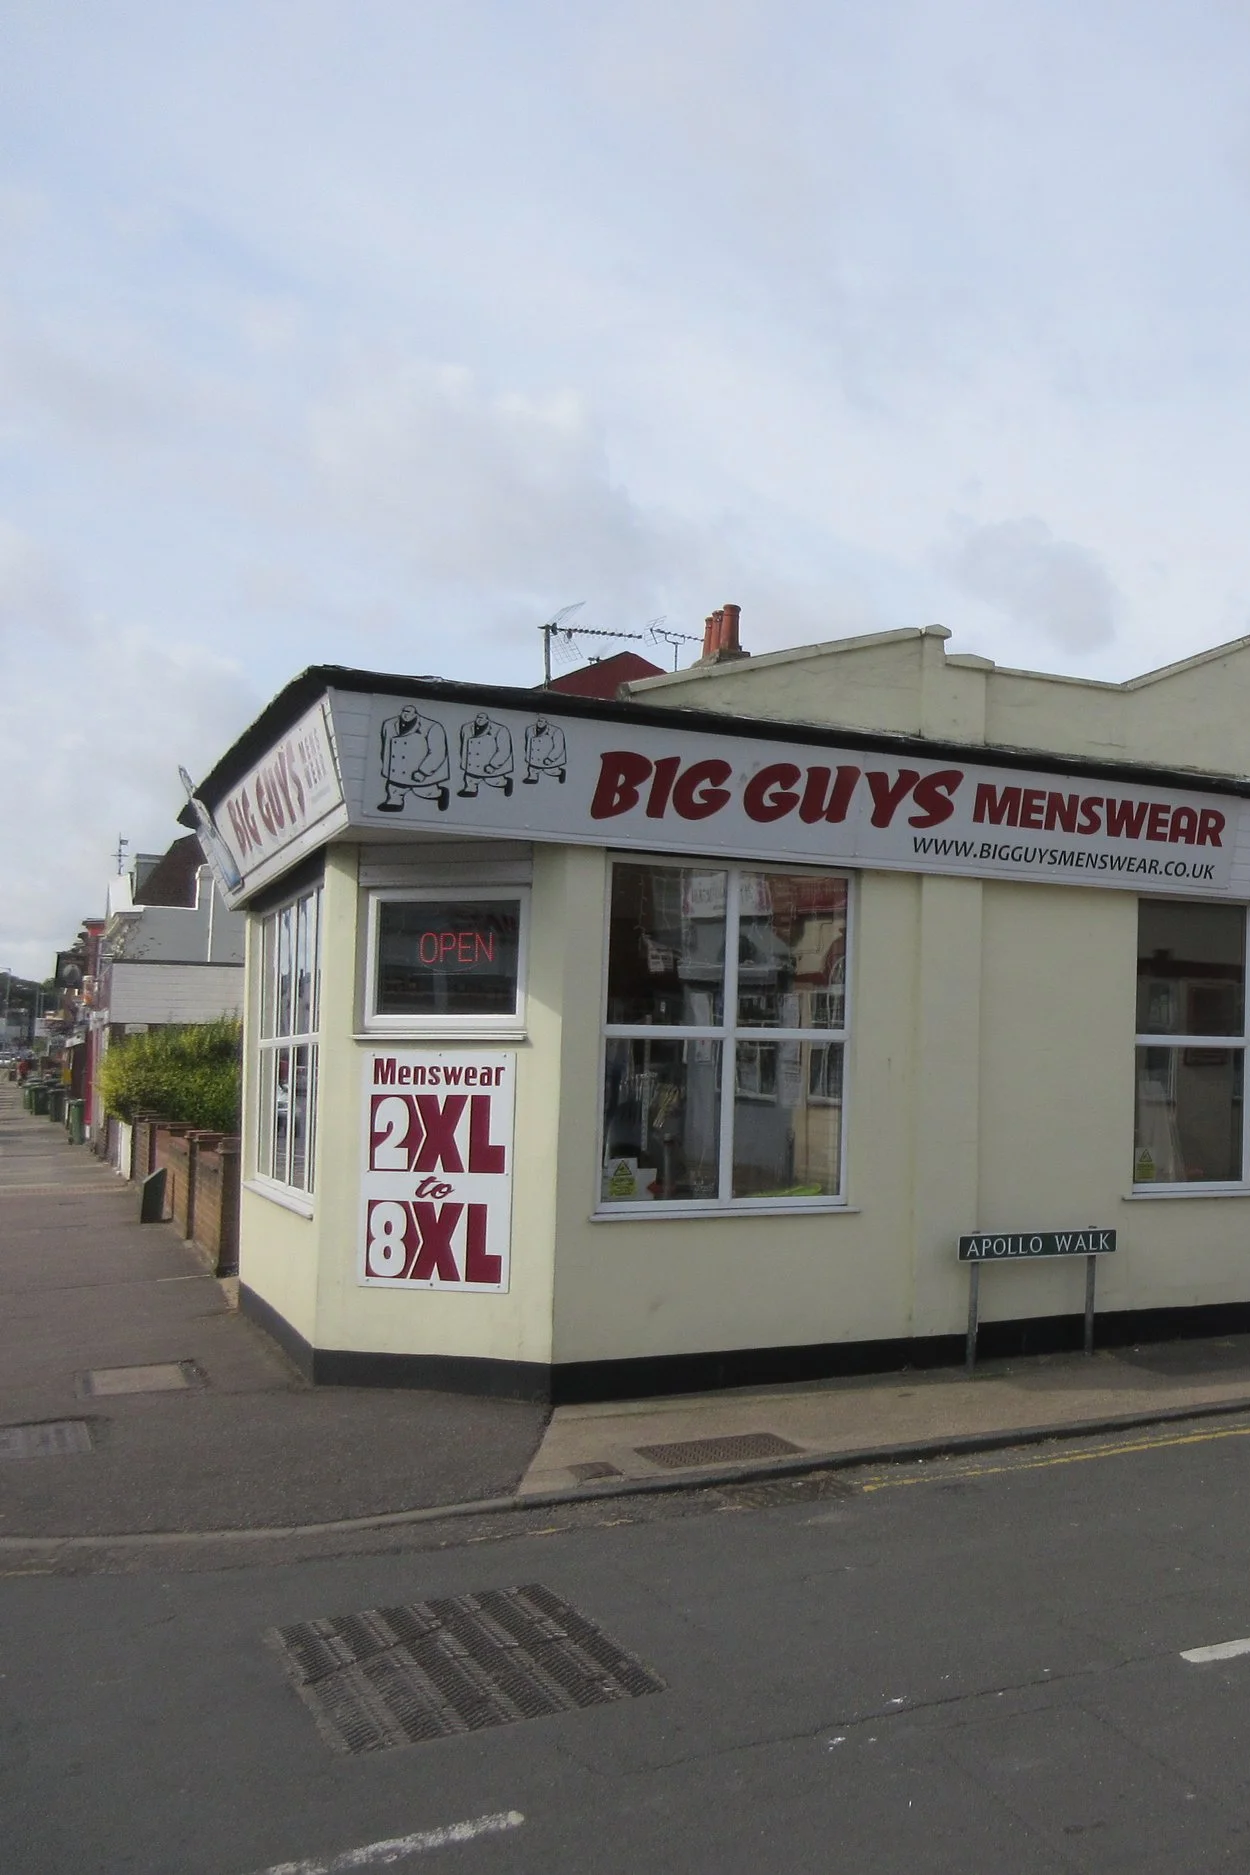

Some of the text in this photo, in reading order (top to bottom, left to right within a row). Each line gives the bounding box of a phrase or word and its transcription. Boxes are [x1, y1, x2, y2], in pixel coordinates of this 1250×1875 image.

[226, 738, 306, 858] BIG GUYS
[591, 750, 1226, 848] BIG GUYS MENSWEAR
[912, 835, 1215, 880] WWW.BIGGUYSMENSWEAR.CO.UK
[419, 932, 495, 964] OPEN
[373, 1057, 506, 1087] Menswear
[369, 1093, 506, 1174] 2XL
[414, 1175, 457, 1200] to
[365, 1199, 502, 1283] 8XL
[966, 1232, 1111, 1257] APOLLO WALK
